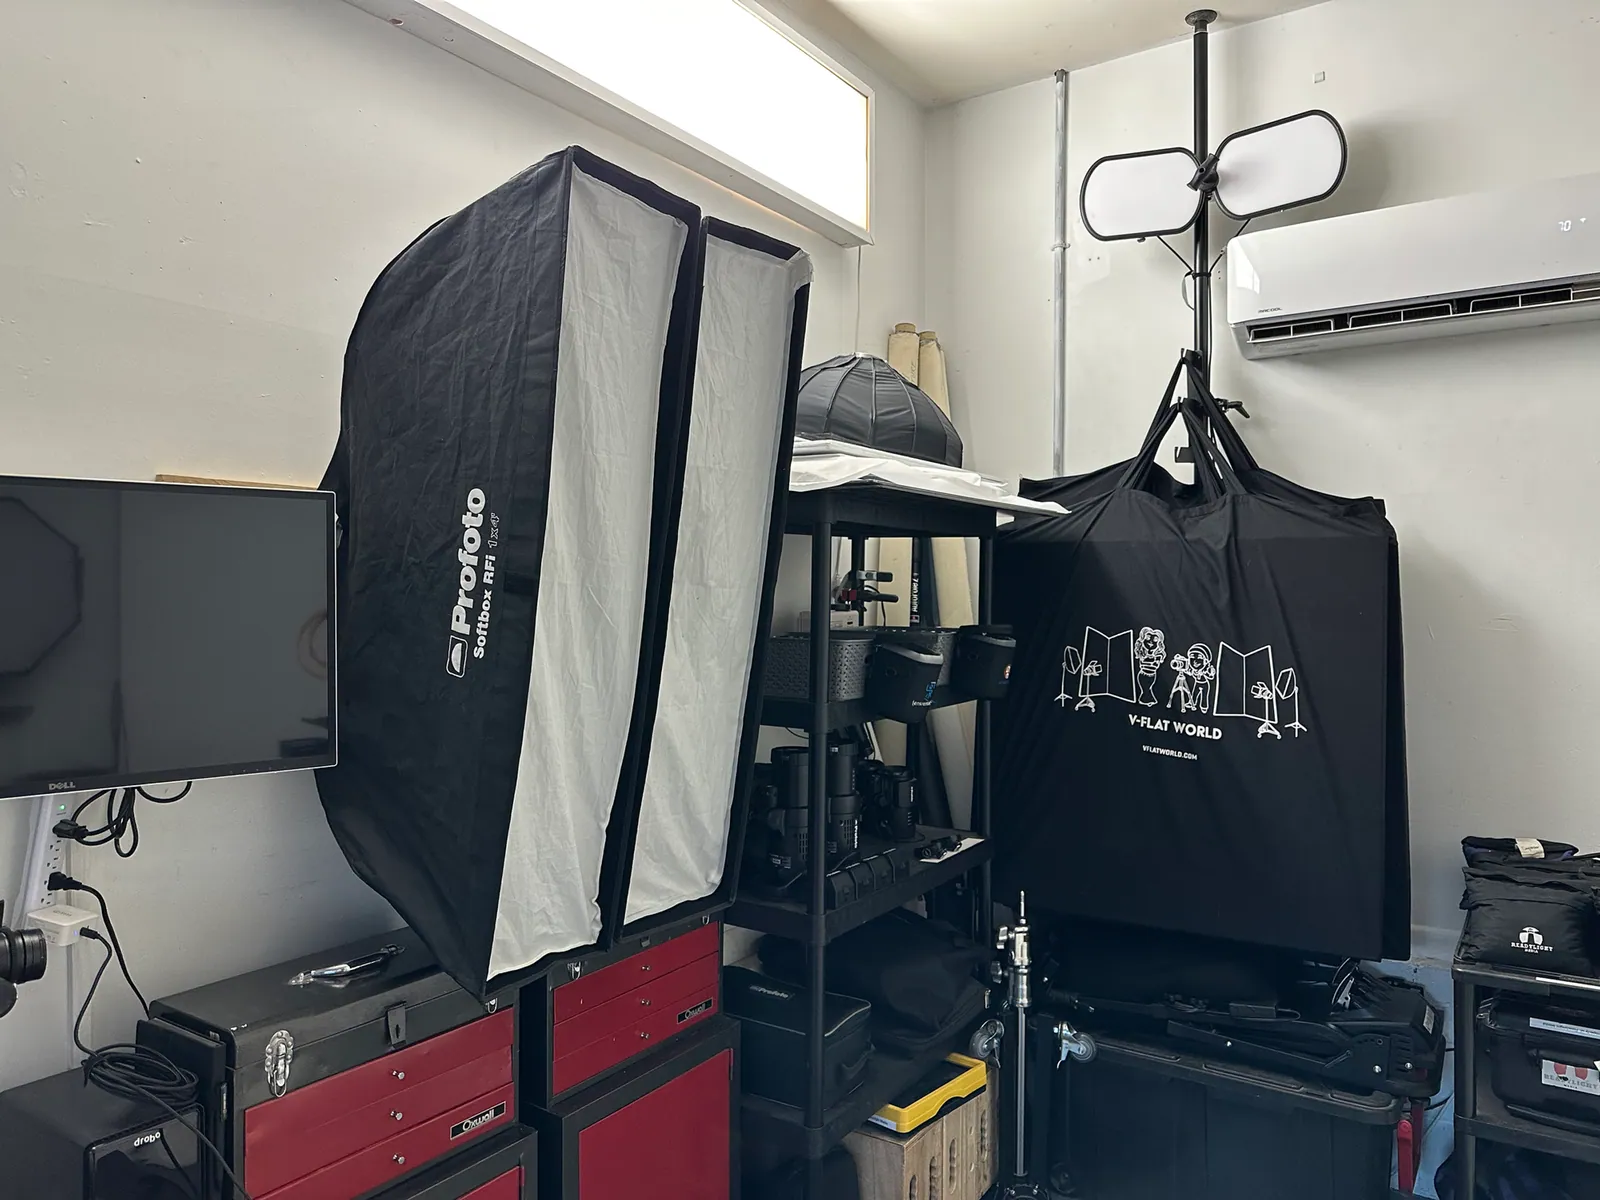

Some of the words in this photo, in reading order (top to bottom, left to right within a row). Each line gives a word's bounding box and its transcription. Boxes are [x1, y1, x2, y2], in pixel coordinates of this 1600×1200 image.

[451, 488, 486, 635] Profoto
[473, 588, 493, 659] Softbox
[483, 554, 496, 585] RFi
[1128, 714, 1170, 732] V-FLAT
[1173, 721, 1222, 740] WORLD
[1142, 745, 1198, 761] VFLATWORLD.COM
[48, 781, 76, 790] DELL
[462, 1108, 495, 1131] Oxwall
[133, 1131, 161, 1147] drobo
